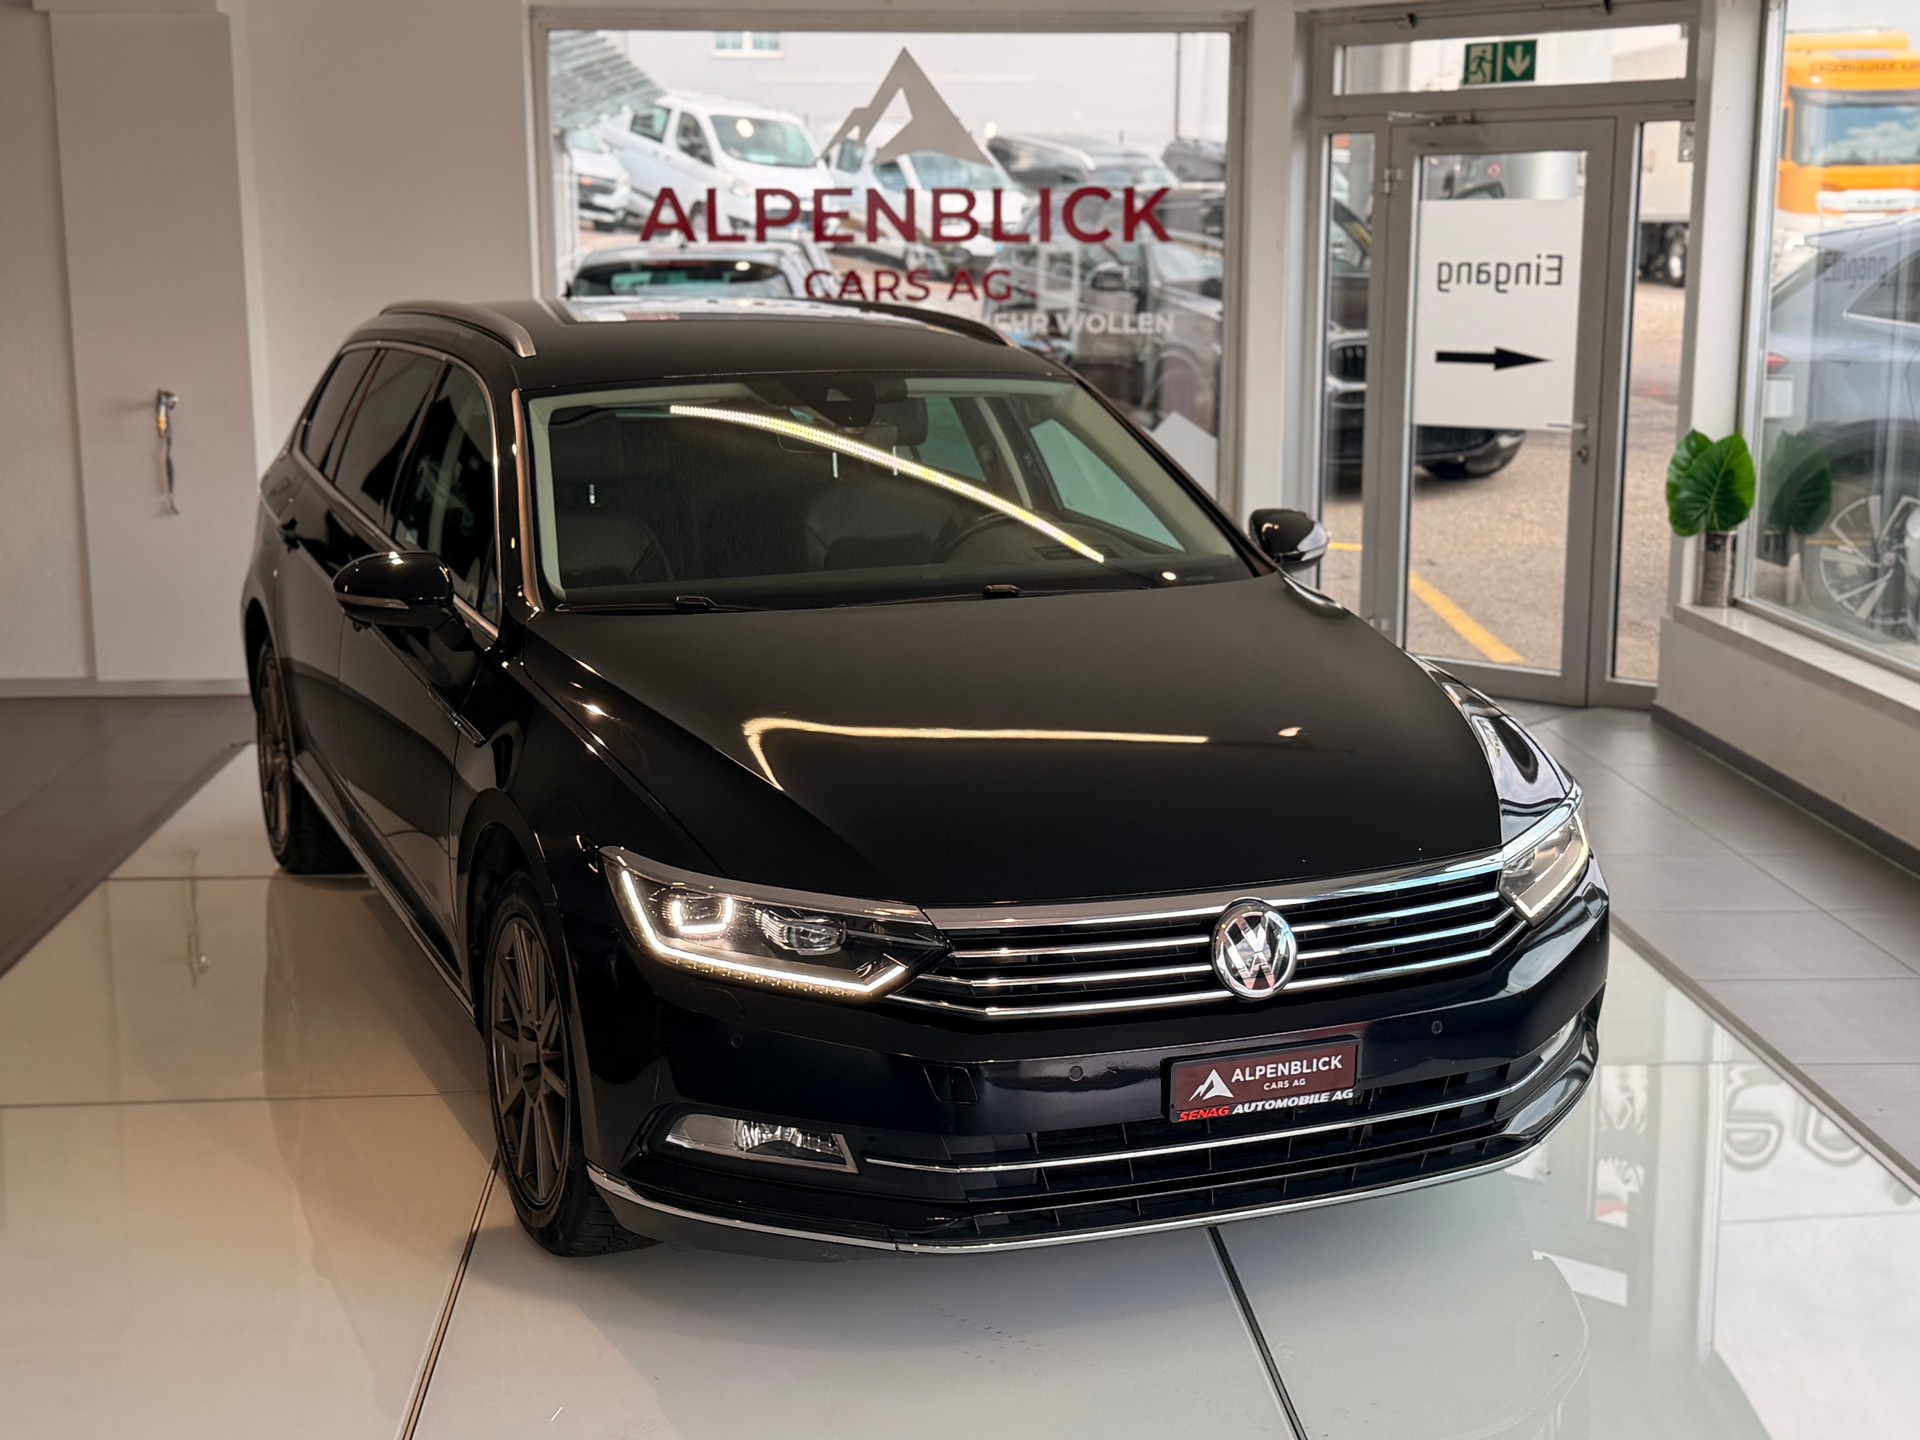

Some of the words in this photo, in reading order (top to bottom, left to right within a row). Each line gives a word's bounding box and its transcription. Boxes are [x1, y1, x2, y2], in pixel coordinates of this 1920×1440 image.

[640, 187, 1173, 243] ALPENBLICK
[805, 269, 931, 301] CARS
[948, 269, 1013, 302] AG
[1055, 312, 1175, 334] WOLLEN
[1231, 1055, 1343, 1083] ALPENBLICK
[1263, 1079, 1290, 1091] CARS
[1292, 1078, 1306, 1087] AG
[1178, 1106, 1230, 1122] SENAG
[1231, 1094, 1329, 1115] AUTOMOBILE
[1331, 1089, 1354, 1101] AG
